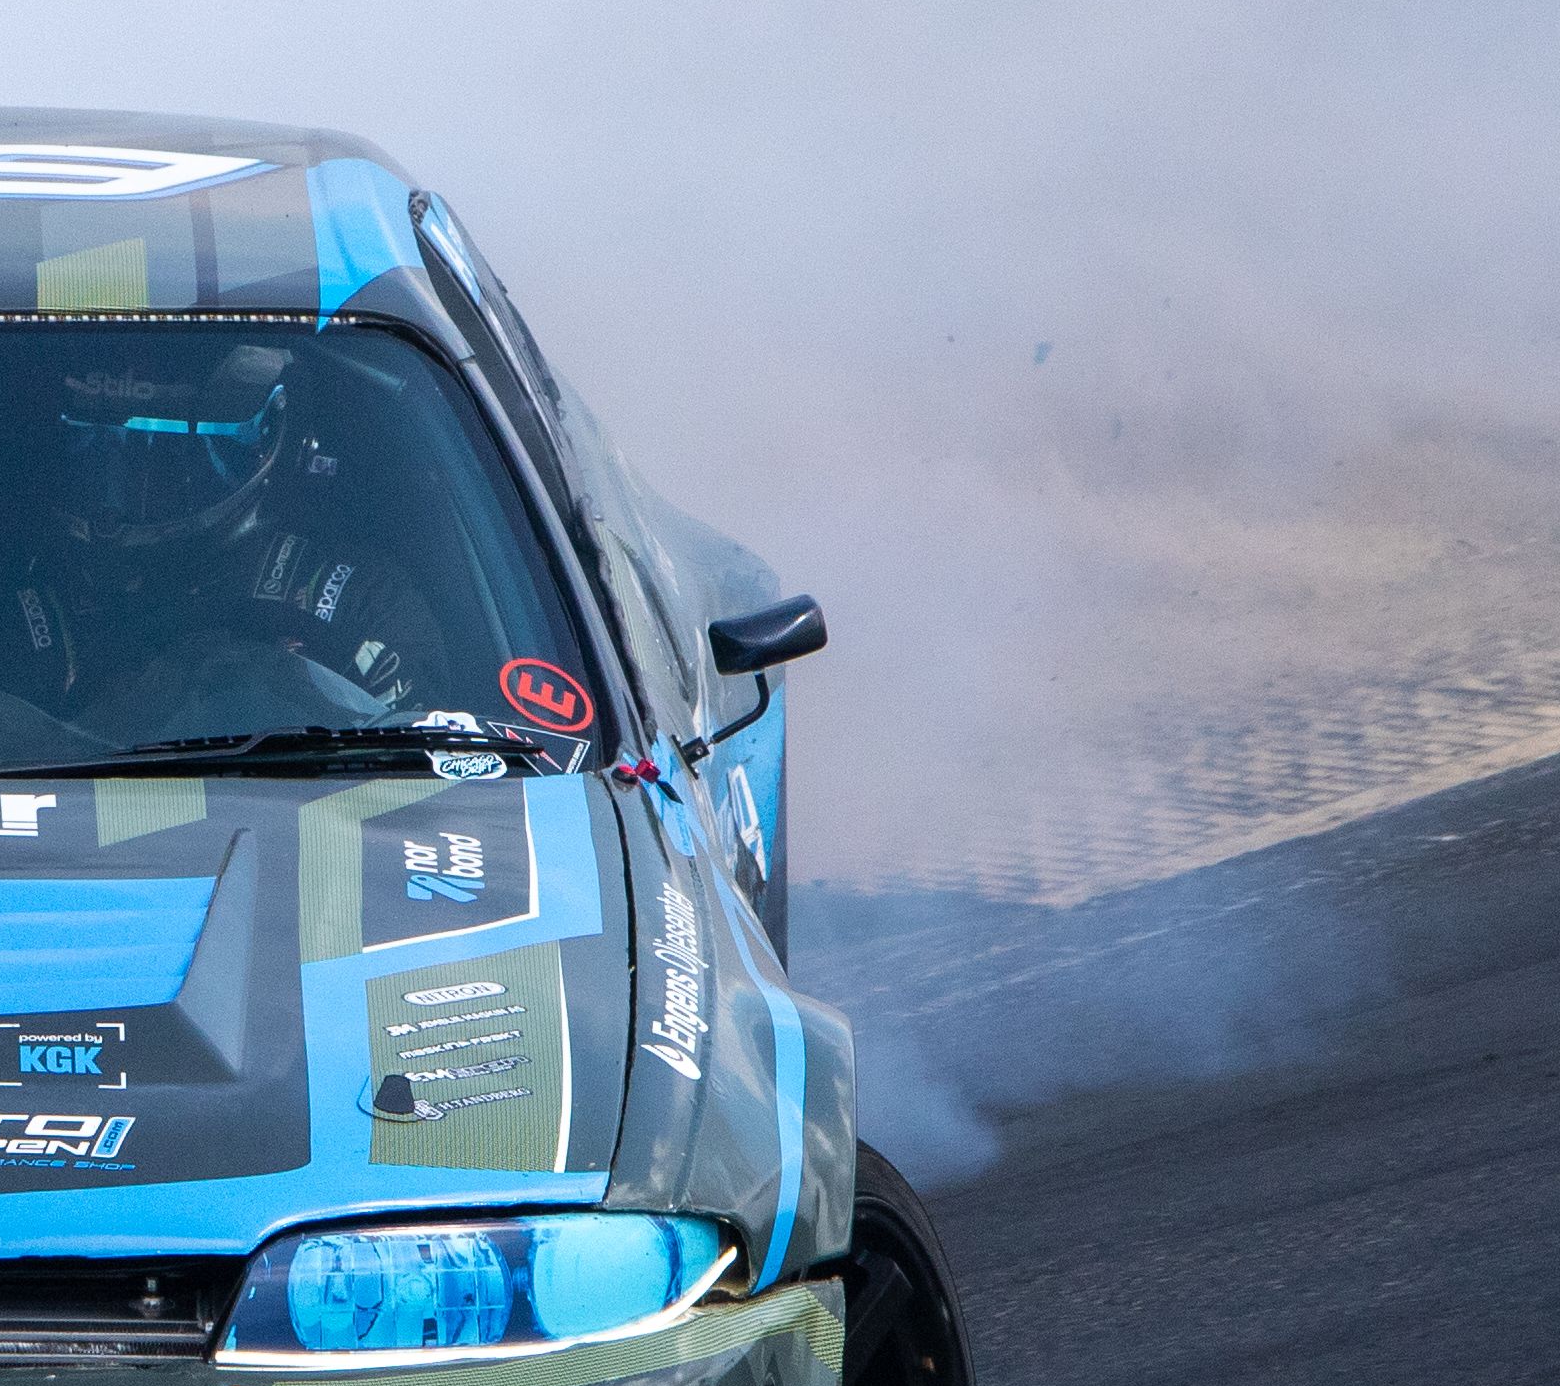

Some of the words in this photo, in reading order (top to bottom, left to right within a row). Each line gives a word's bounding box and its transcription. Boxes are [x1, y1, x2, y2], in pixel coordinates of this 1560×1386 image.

[315, 563, 353, 621] sparco
[403, 839, 439, 874] nor
[652, 881, 710, 976] Oljesenter
[415, 982, 493, 1004] NITRON
[651, 967, 710, 1054] Engens
[19, 1033, 82, 1043] powered
[84, 1033, 103, 1044] by
[20, 1045, 102, 1074] KGK
[73, 1161, 137, 1171] SHOP
